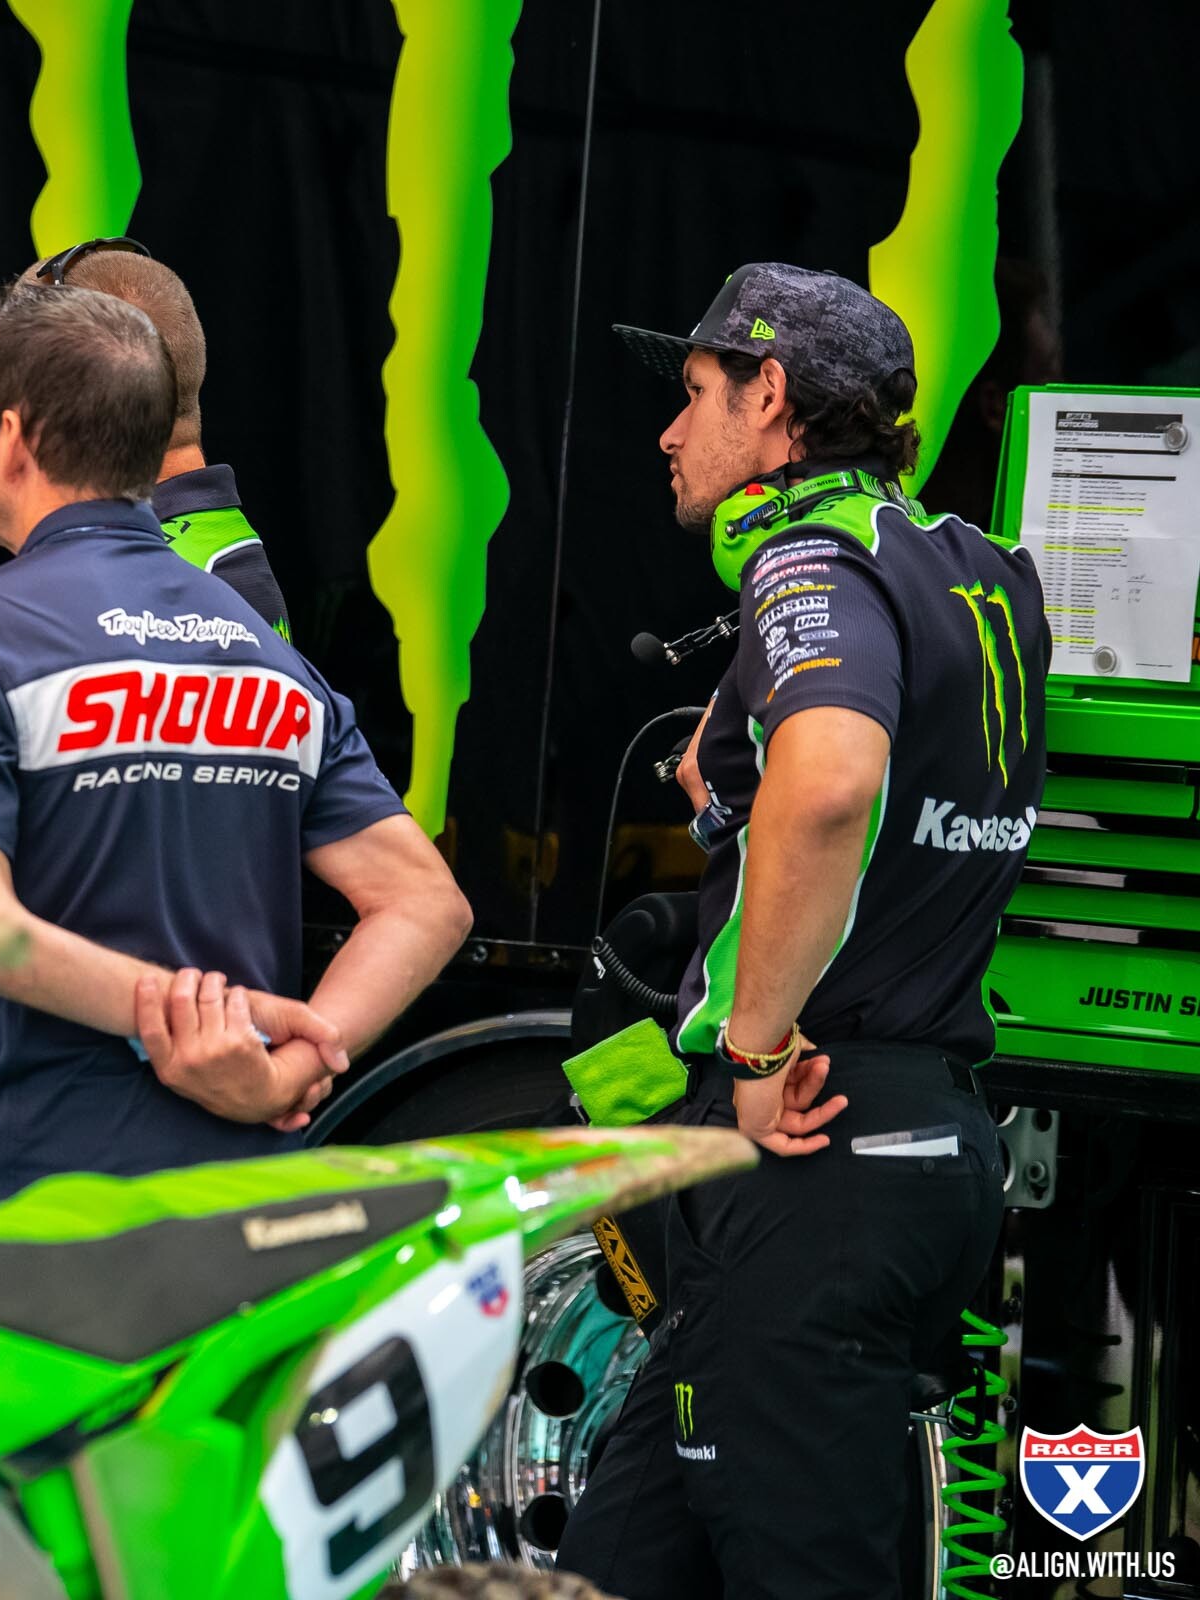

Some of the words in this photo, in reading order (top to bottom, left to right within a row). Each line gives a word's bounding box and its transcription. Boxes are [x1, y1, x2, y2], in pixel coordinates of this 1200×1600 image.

[802, 475, 849, 492] DOMINI
[99, 608, 146, 645] Troy
[143, 611, 177, 641] Lee
[796, 613, 829, 631] UNI
[57, 671, 311, 753] SHOWA
[72, 761, 183, 792] RACNG
[192, 765, 301, 792] SERVIC
[912, 797, 1038, 852] Kawasa
[1079, 986, 1172, 1014] JUSTIN
[1178, 995, 1200, 1017] S
[295, 1335, 437, 1576] 9
